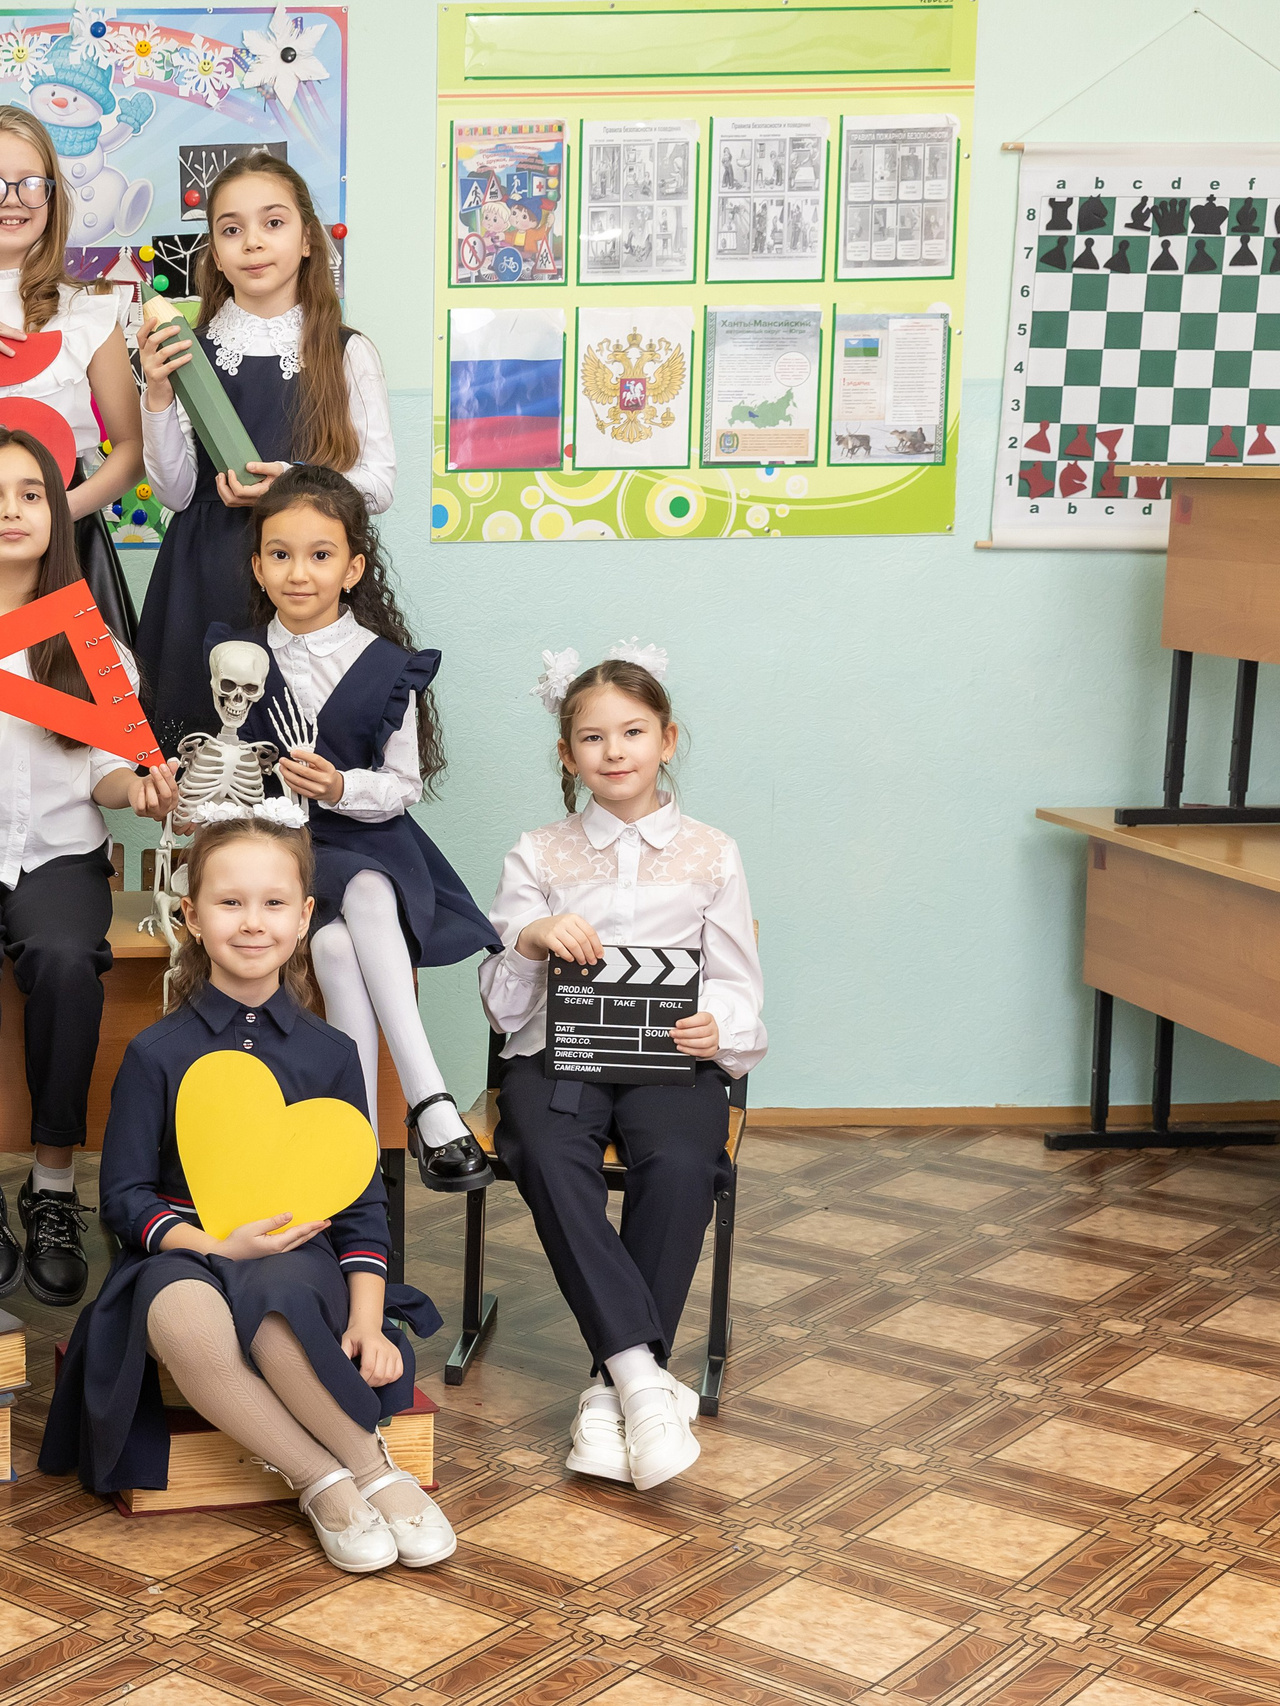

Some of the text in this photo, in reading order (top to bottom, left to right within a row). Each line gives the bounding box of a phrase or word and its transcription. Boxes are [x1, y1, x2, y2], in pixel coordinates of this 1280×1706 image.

[851, 133, 876, 141] ПРАВИЛА
[907, 132, 948, 140] БЕЗОПАСНОСТИ
[1056, 176, 1256, 190] a b c d e f
[1026, 208, 1036, 222] 8
[1024, 246, 1034, 260] 7
[1020, 284, 1030, 299] 6
[720, 319, 812, 328] Ханты-Мансийский
[1016, 323, 1028, 337] 5
[1013, 361, 1024, 374] 4
[1010, 398, 1021, 412] 3
[1008, 436, 1018, 450] 2
[1005, 474, 1014, 487] 1
[1029, 502, 1152, 516] a b c d
[73, 610, 148, 762] 1 2 3 4 5 6
[557, 985, 595, 994] PROD.NO.
[564, 997, 594, 1005] SCENE
[555, 1036, 592, 1044] PROD.CO.
[644, 1030, 670, 1038] SOUN
[555, 1050, 594, 1058] DIRECTOR
[554, 1064, 602, 1072] CAMERAMAN
